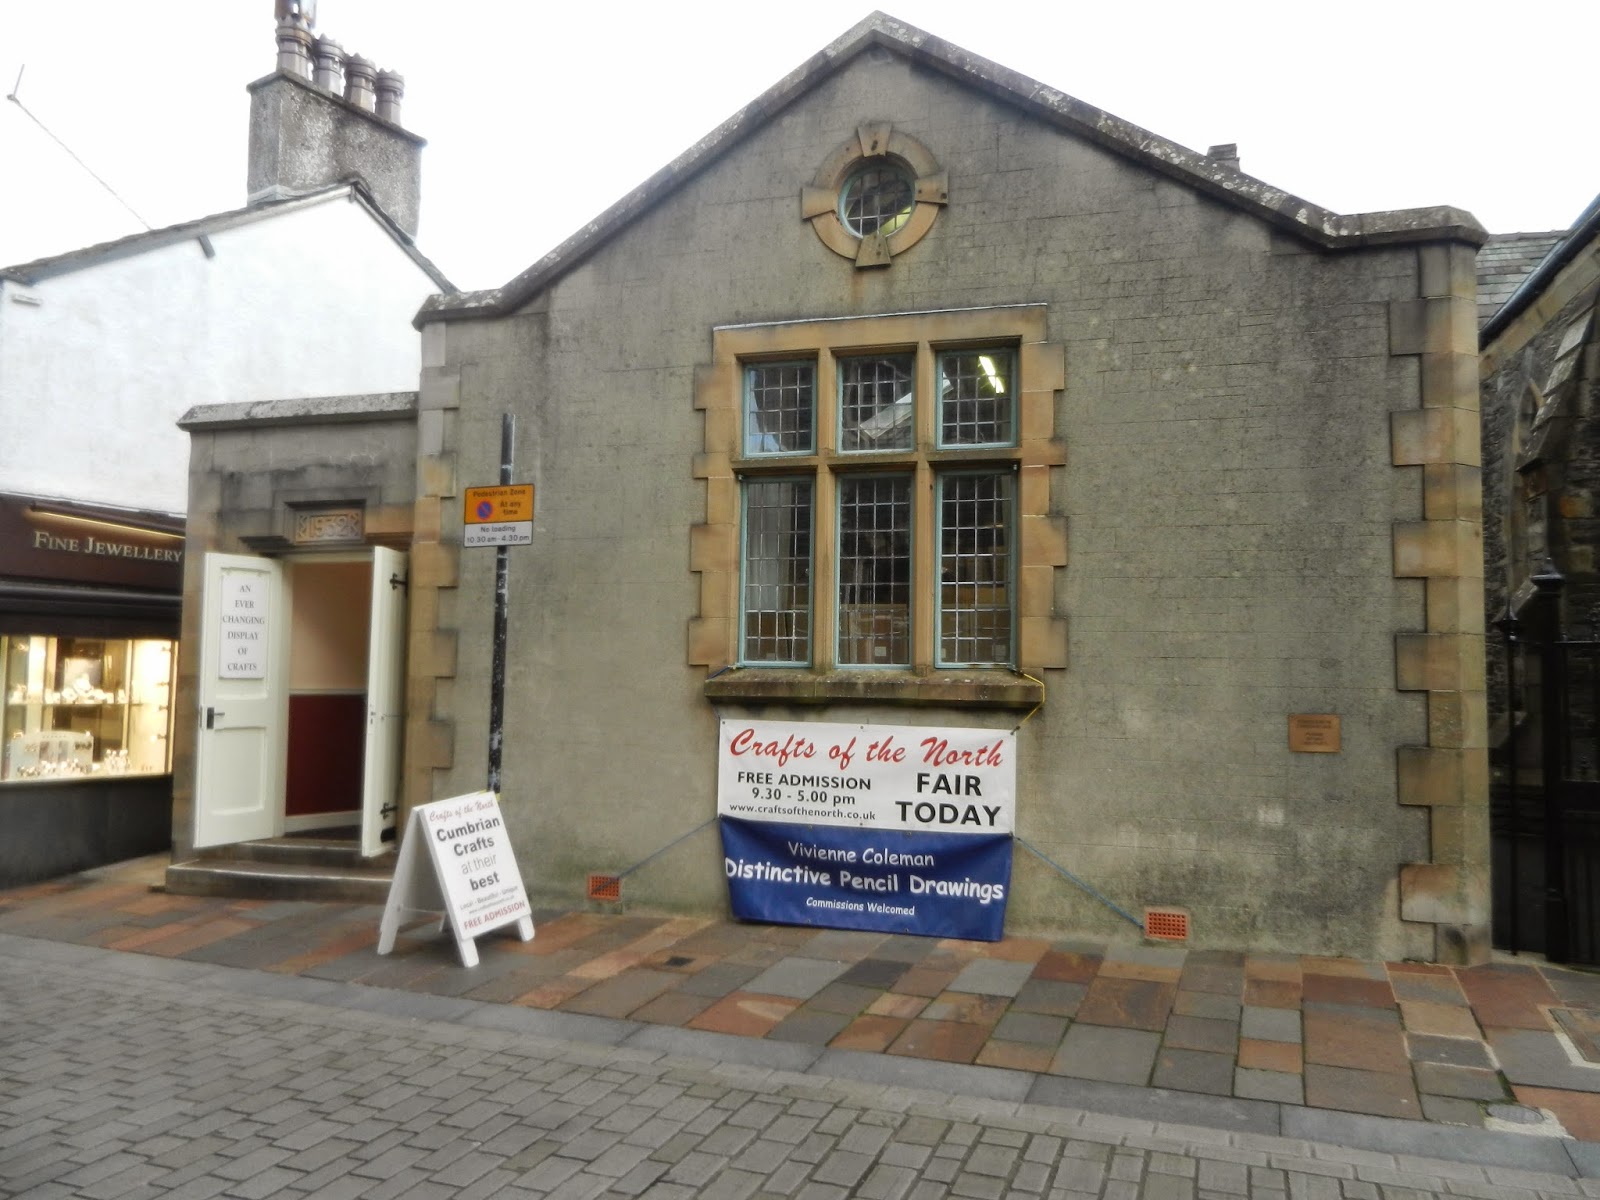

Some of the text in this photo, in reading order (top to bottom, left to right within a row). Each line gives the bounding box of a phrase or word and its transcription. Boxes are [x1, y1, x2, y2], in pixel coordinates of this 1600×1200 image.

[473, 488, 526, 498] Pedestrian Zone
[32, 530, 182, 562] FINE JEWELLERY
[240, 585, 251, 593] AN
[235, 600, 254, 608] EVER
[222, 615, 265, 624] CHANGING
[228, 631, 259, 640] DISPLAY
[238, 647, 248, 656] OF
[227, 663, 257, 671] CRAFTS
[730, 728, 1004, 770] Crafts of the North
[737, 771, 872, 790] FREE ADMISSION
[916, 772, 982, 796] FAIR
[752, 787, 782, 800] 9.30
[797, 790, 828, 804] 5.00
[833, 794, 855, 806] pm
[729, 804, 876, 820] www.craftsofthenorth.co.uk
[895, 800, 1002, 826] TODAY
[436, 817, 500, 842] Cumbrian
[454, 837, 494, 856] Crafts
[787, 841, 934, 866] Vivienne Coleman
[461, 854, 496, 874] at their
[470, 871, 500, 891] best
[724, 857, 1004, 904] Distinctive Pencil Drawings
[464, 916, 482, 930] FREE
[484, 900, 525, 922] ADMISSION
[806, 897, 915, 916] Commissions Welcomed
